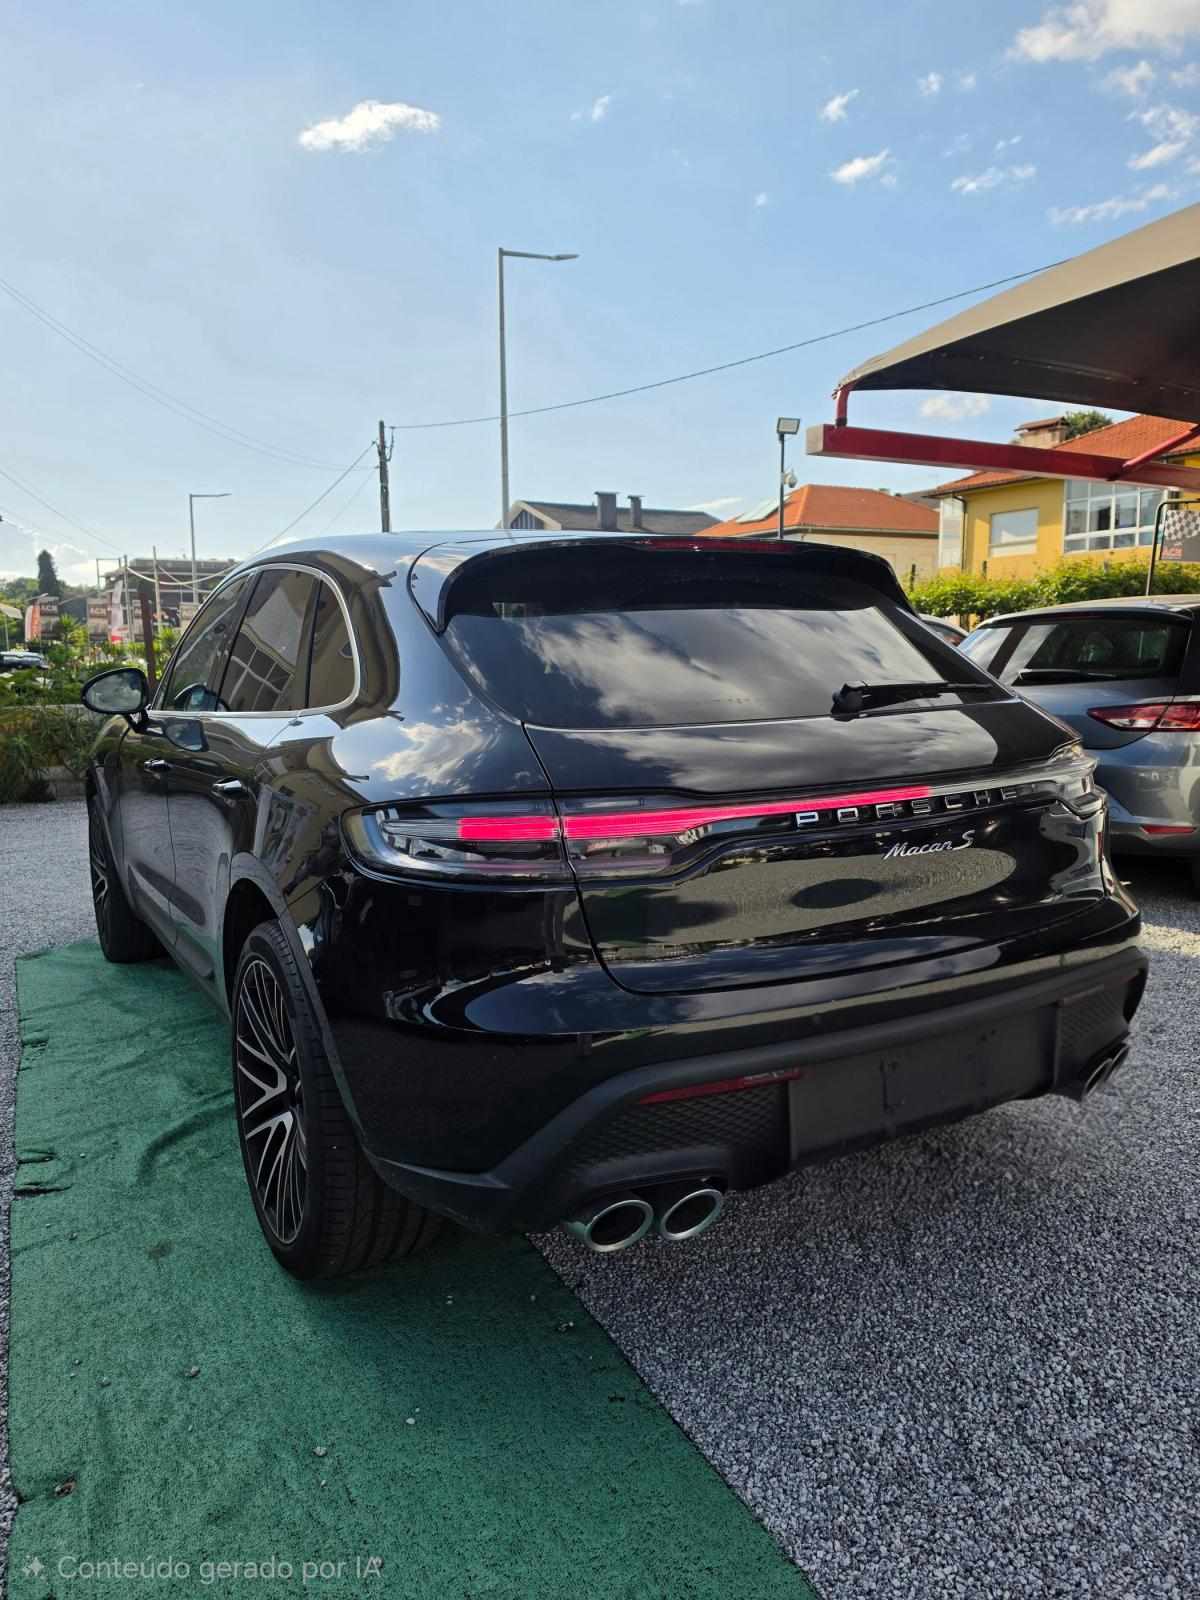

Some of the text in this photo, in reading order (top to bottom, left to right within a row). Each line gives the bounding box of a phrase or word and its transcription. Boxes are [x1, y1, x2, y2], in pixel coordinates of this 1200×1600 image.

[796, 787, 1017, 827] PORSCHE
[884, 830, 975, 859] Macan S
